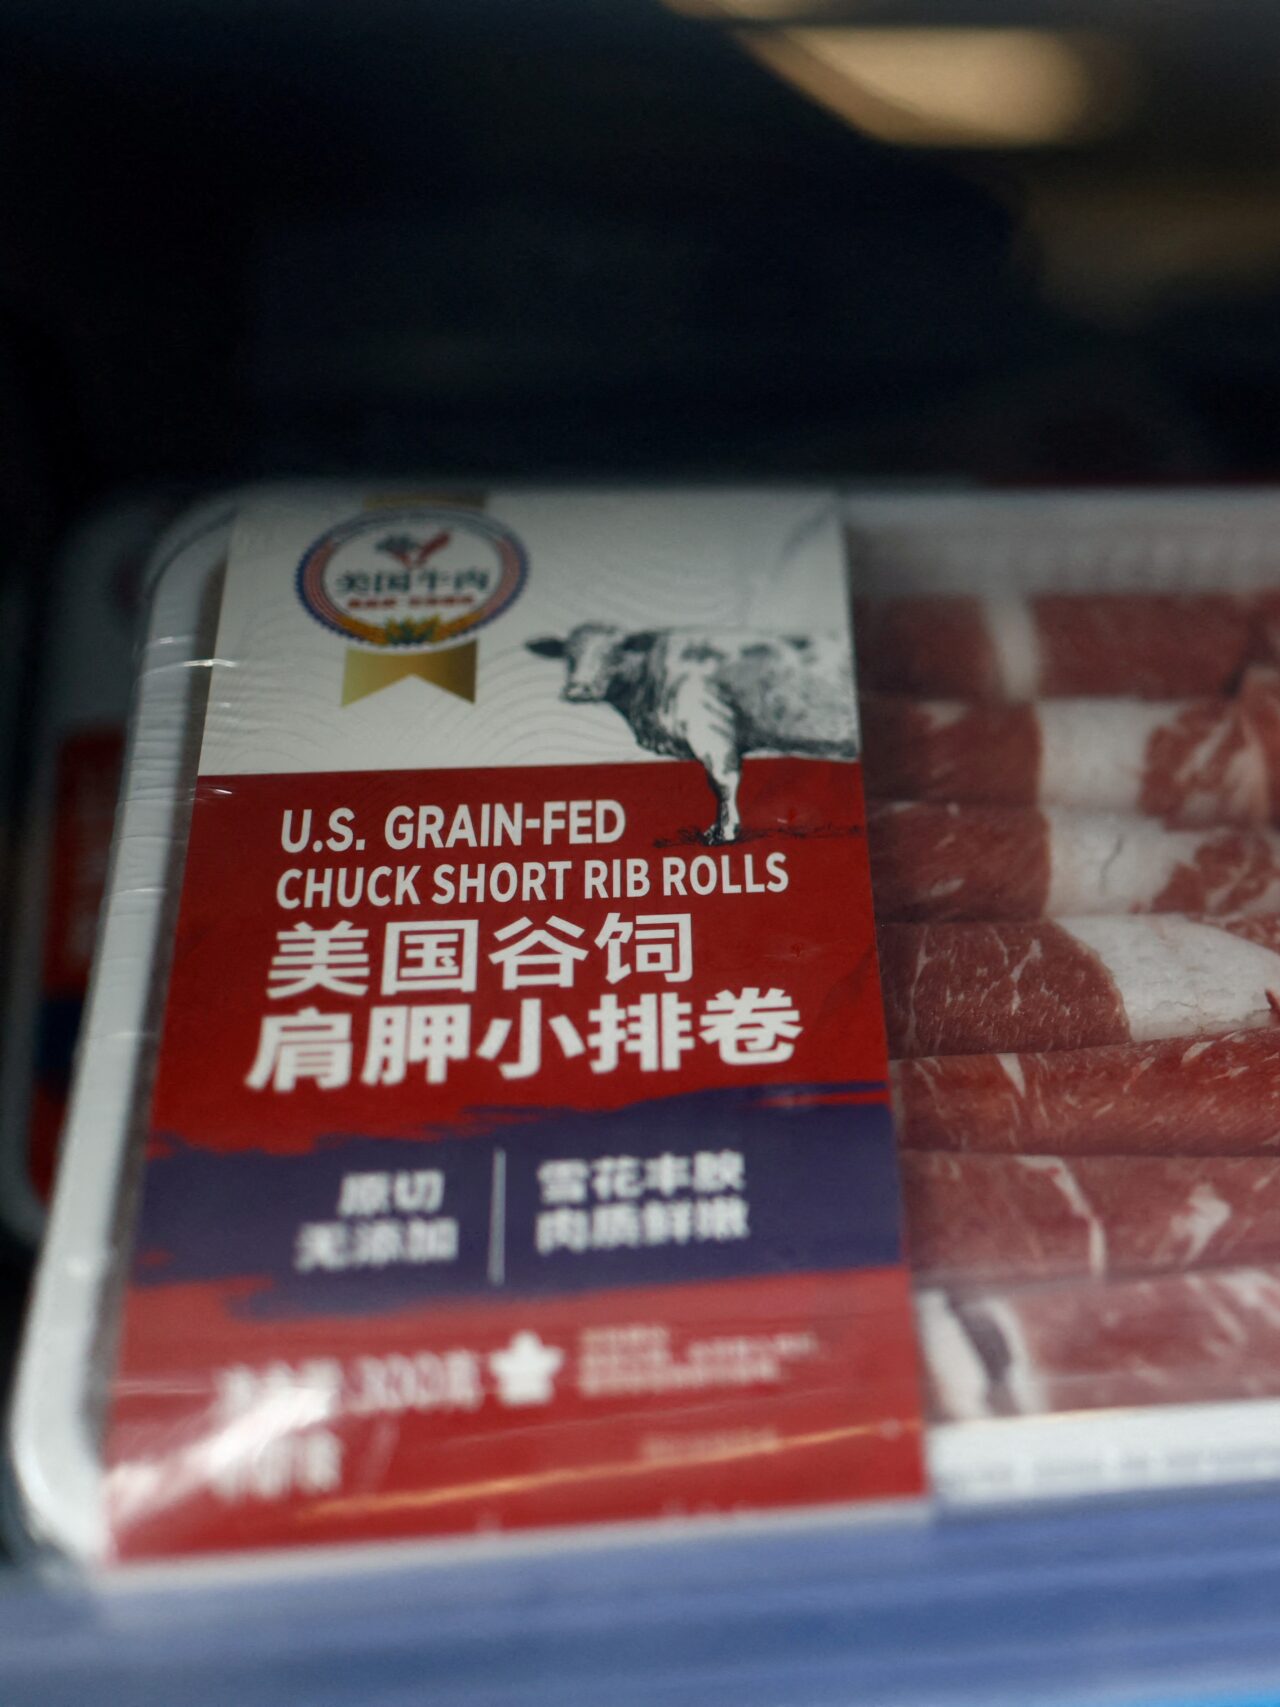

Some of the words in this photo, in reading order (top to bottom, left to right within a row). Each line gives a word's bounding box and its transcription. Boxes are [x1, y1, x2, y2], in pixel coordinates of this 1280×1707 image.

[280, 808, 366, 853] U.S.
[384, 799, 627, 849] GRAIN-FED
[275, 864, 422, 909] CHUCK
[431, 860, 572, 905] SHORT
[583, 857, 650, 899] RIB
[662, 852, 790, 896] ROLLS
[266, 912, 694, 999] 美国谷饲
[245, 986, 803, 1092] 肩胛小排卷
[338, 1169, 445, 1217] 原切
